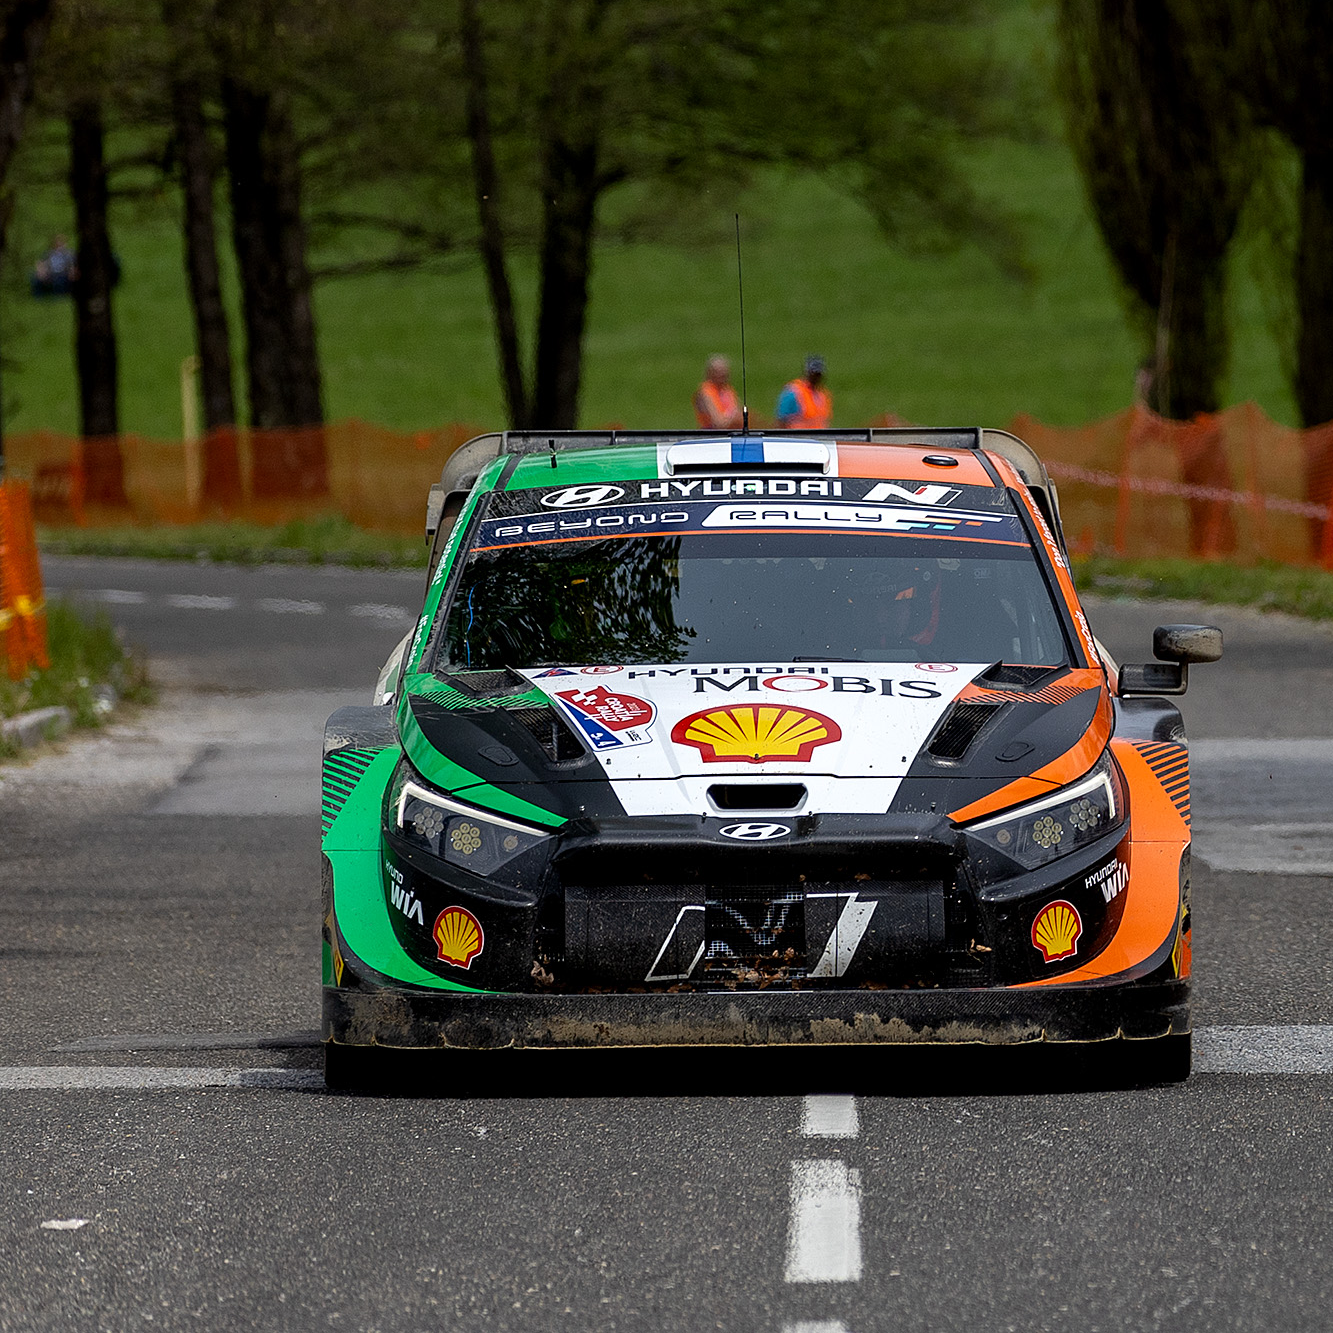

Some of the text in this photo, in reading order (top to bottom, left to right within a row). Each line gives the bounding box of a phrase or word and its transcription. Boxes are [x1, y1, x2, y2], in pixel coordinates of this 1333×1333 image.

[640, 480, 843, 499] HYUNDAI
[495, 510, 882, 538] BEYOND RALLY
[628, 667, 829, 679] HYUNDAI
[692, 675, 942, 699] MOBIS
[1084, 858, 1118, 889] HYUNDAI
